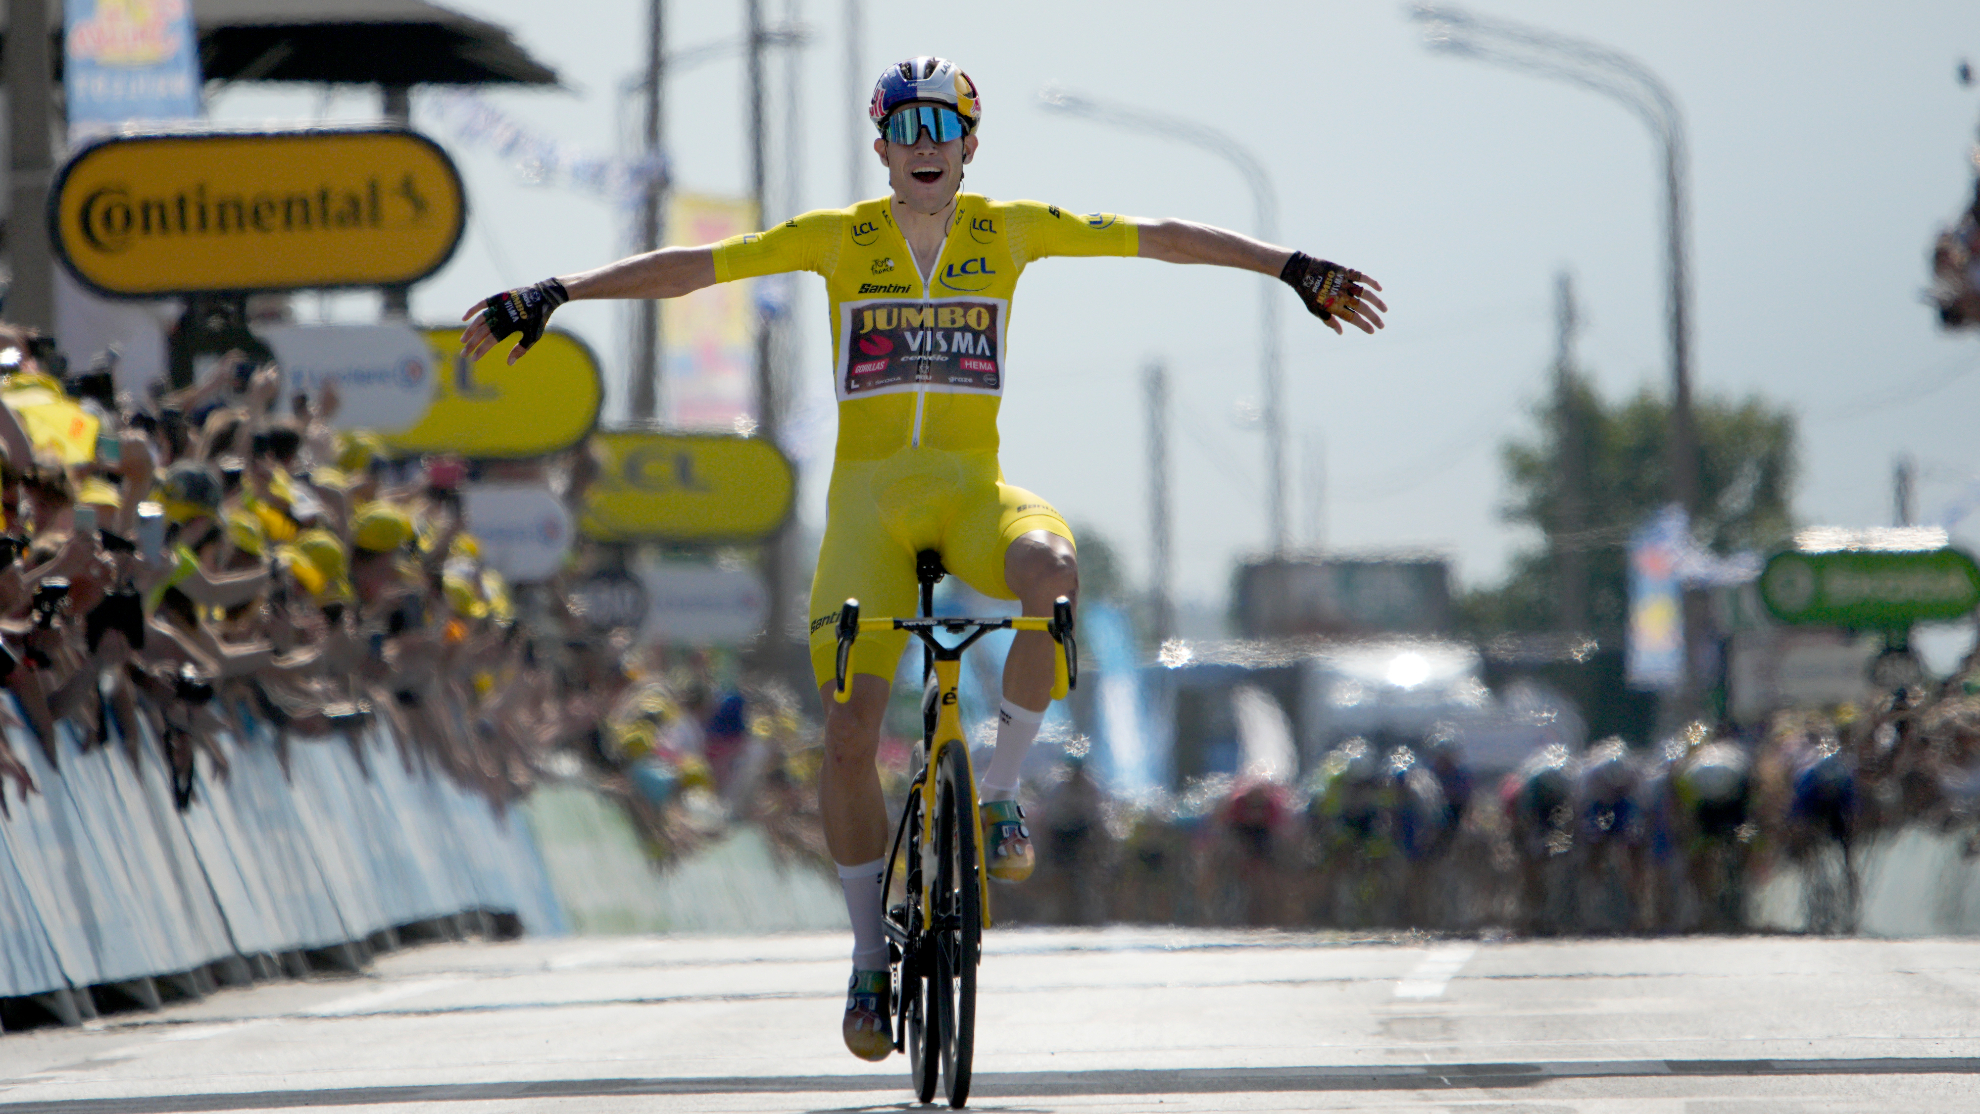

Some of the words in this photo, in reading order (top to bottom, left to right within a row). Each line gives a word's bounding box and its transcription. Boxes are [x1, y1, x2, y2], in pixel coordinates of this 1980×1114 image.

[78, 176, 385, 254] Continental
[853, 222, 879, 237] LCL
[972, 218, 997, 233] LCL
[946, 257, 996, 278] LCL
[858, 283, 912, 294] Santini
[859, 306, 990, 334] JUMBO
[903, 331, 991, 357] VISMA
[854, 361, 885, 374] GORILLAS
[965, 360, 993, 371] HEMA
[949, 376, 973, 384] graze
